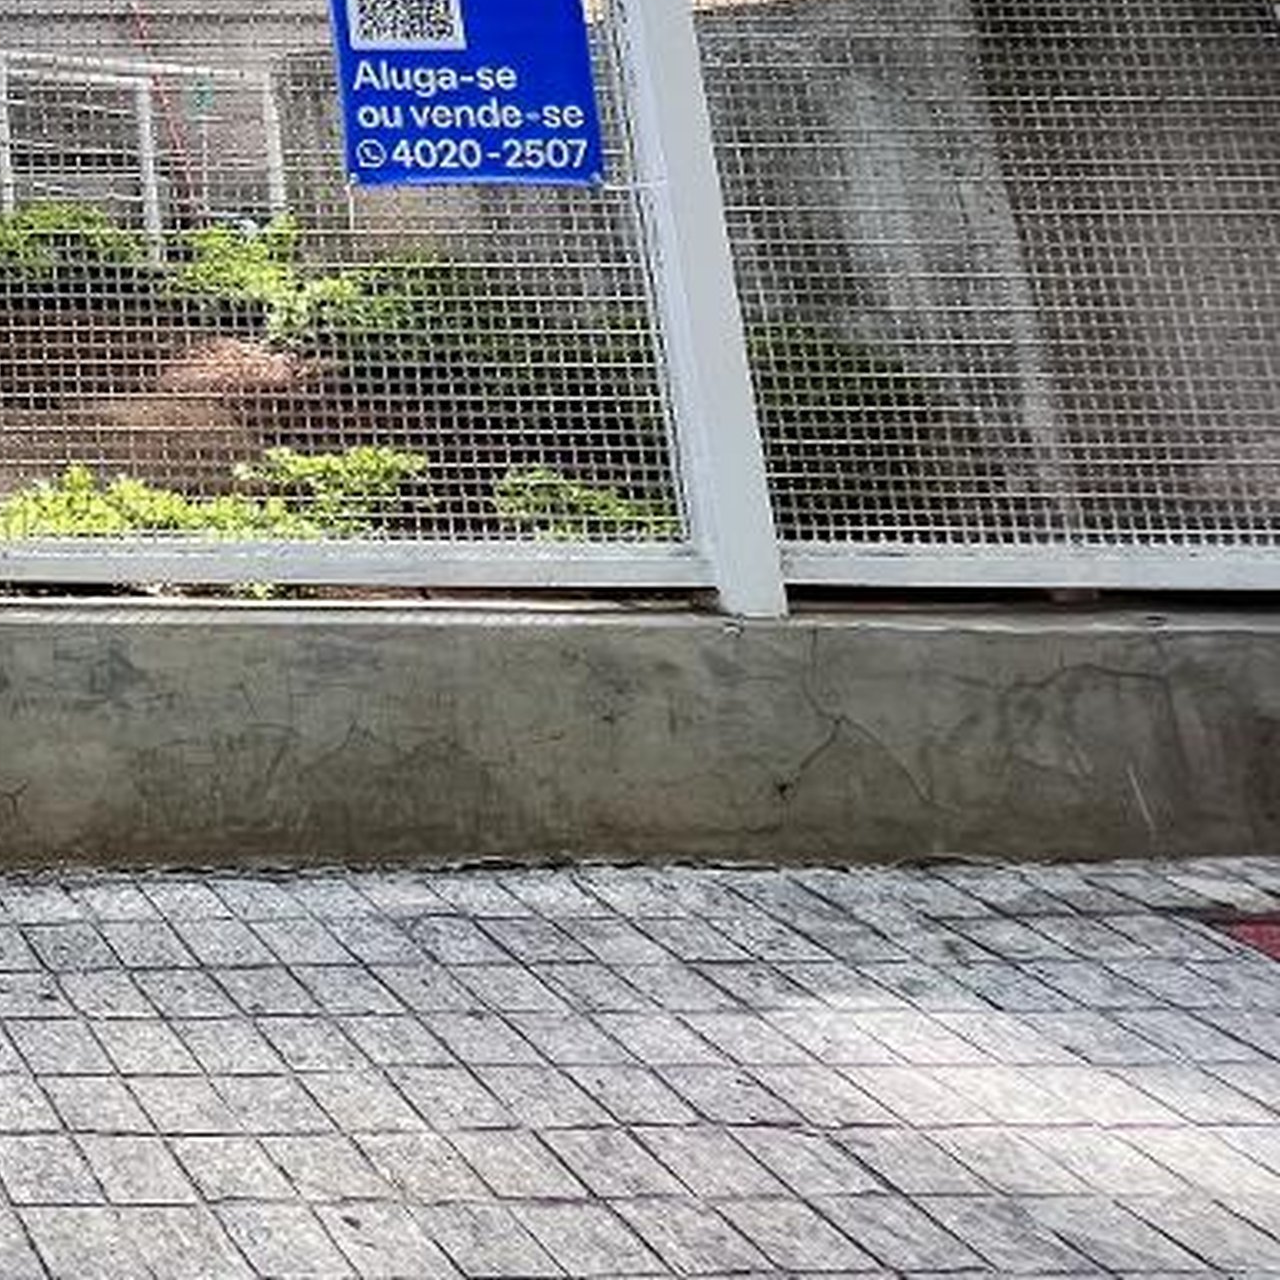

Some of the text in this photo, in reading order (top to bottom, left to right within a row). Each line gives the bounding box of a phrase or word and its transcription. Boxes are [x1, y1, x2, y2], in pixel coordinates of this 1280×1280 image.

[352, 60, 518, 97] Aluga-se
[357, 97, 584, 128] ou vende-se
[391, 139, 587, 167] 4020-2507
